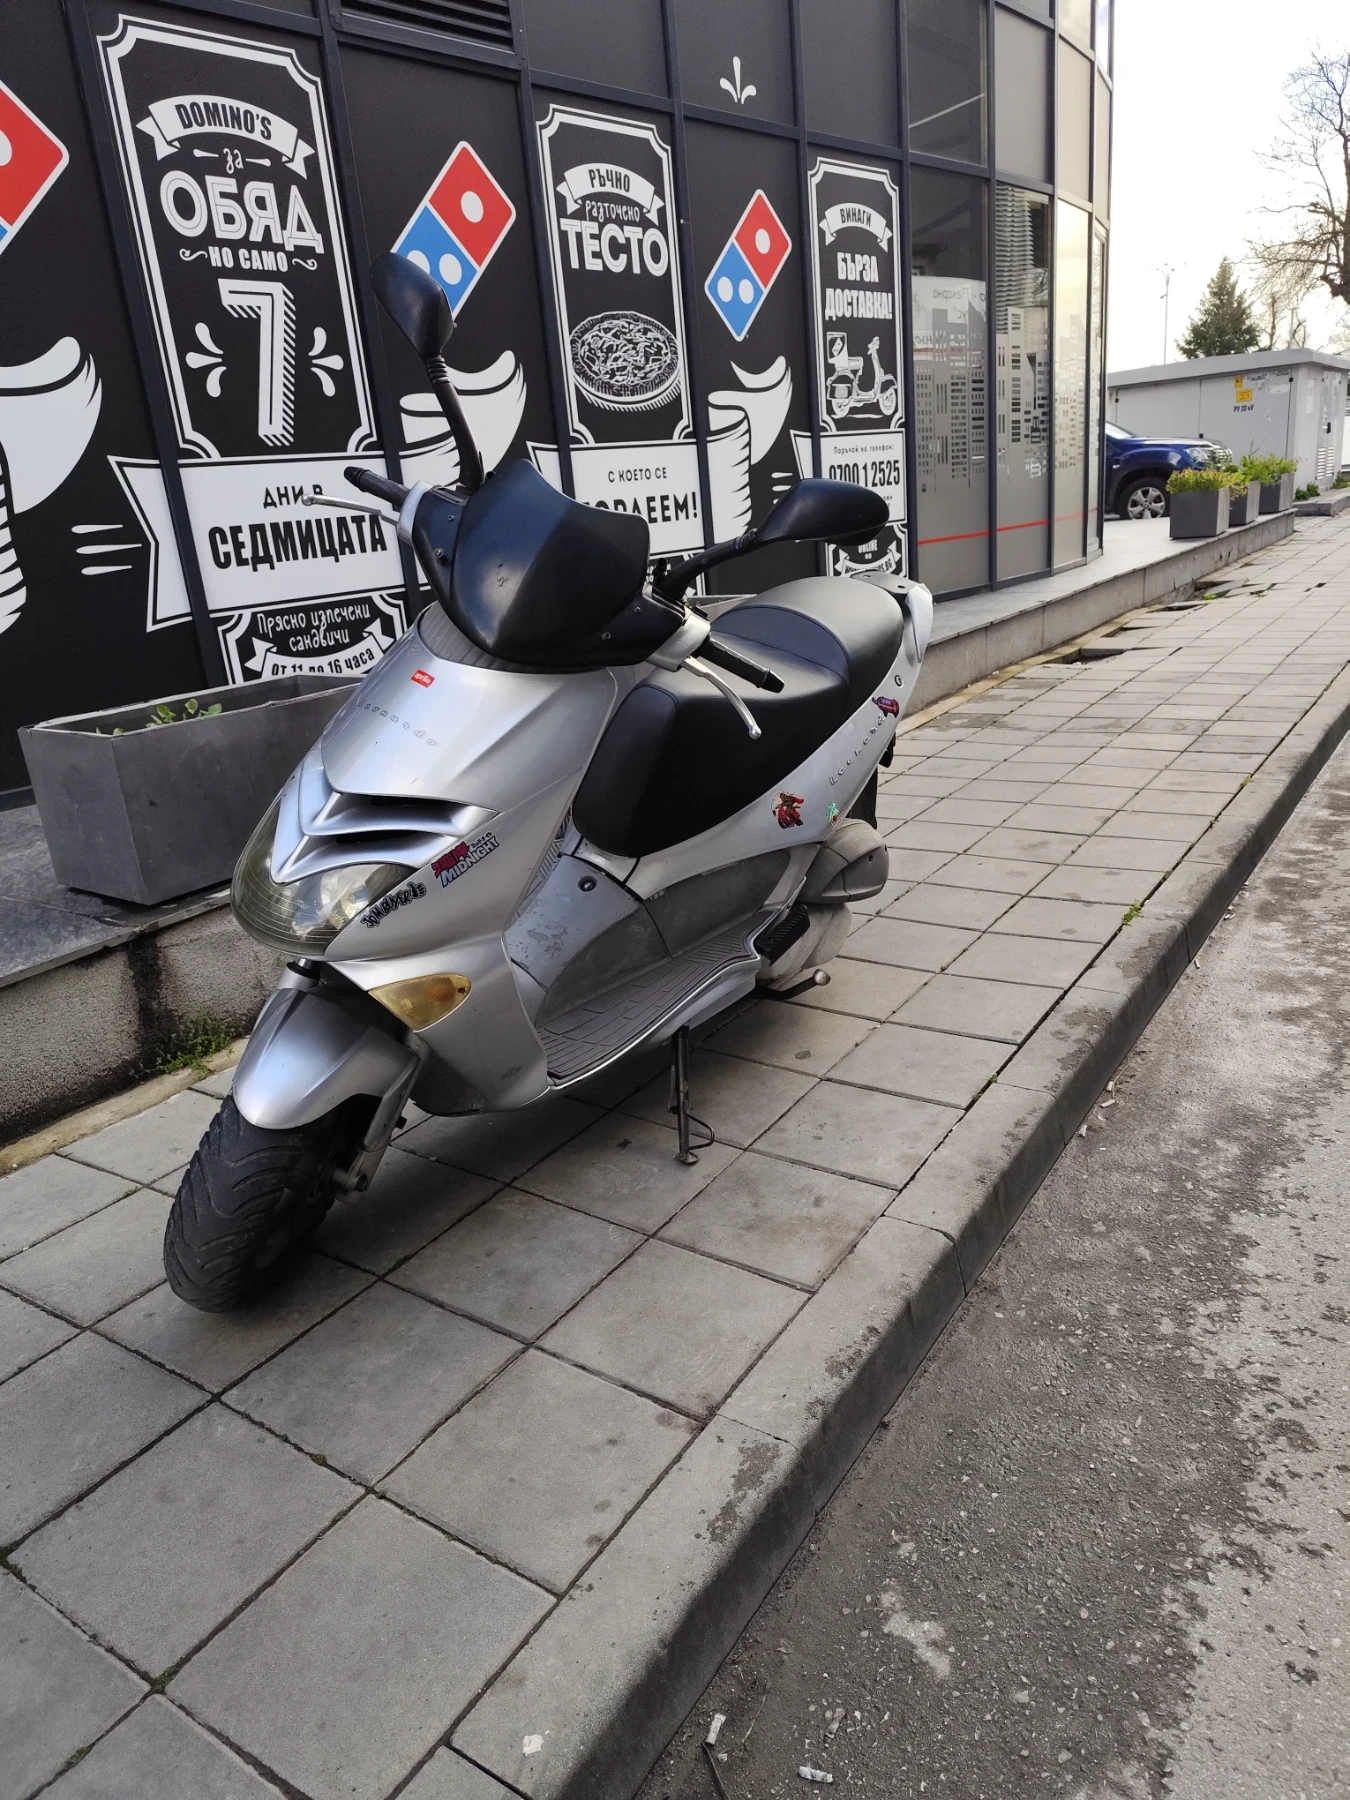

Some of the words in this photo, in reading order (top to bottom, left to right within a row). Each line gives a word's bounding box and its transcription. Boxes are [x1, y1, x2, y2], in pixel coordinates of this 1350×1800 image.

[175, 101, 272, 141] DOMINO'S
[223, 148, 244, 174] за
[588, 168, 631, 193] РЪЧНО
[160, 170, 324, 254] ОБЯД
[585, 200, 641, 223] разточено
[839, 208, 872, 228] ВИНАГИ
[208, 246, 234, 268] НО
[239, 249, 289, 272] САМО
[559, 217, 669, 277] ТЕСТО
[837, 252, 879, 283] БЪРЗА
[825, 288, 893, 321] ДОСТАВКА!
[218, 278, 297, 447] 7
[608, 470, 615, 483] С
[619, 468, 652, 483] КОЕТО
[655, 467, 668, 479] СЕ
[263, 484, 304, 509] ДНИ
[208, 514, 388, 572] СЕДМИЦАТА
[257, 612, 306, 638] Прясно
[311, 604, 371, 630] изпечени
[289, 629, 350, 652] сандвичи
[327, 659, 343, 673] 16
[345, 648, 375, 671] часа
[439, 835, 500, 888] MIDNIGHT
